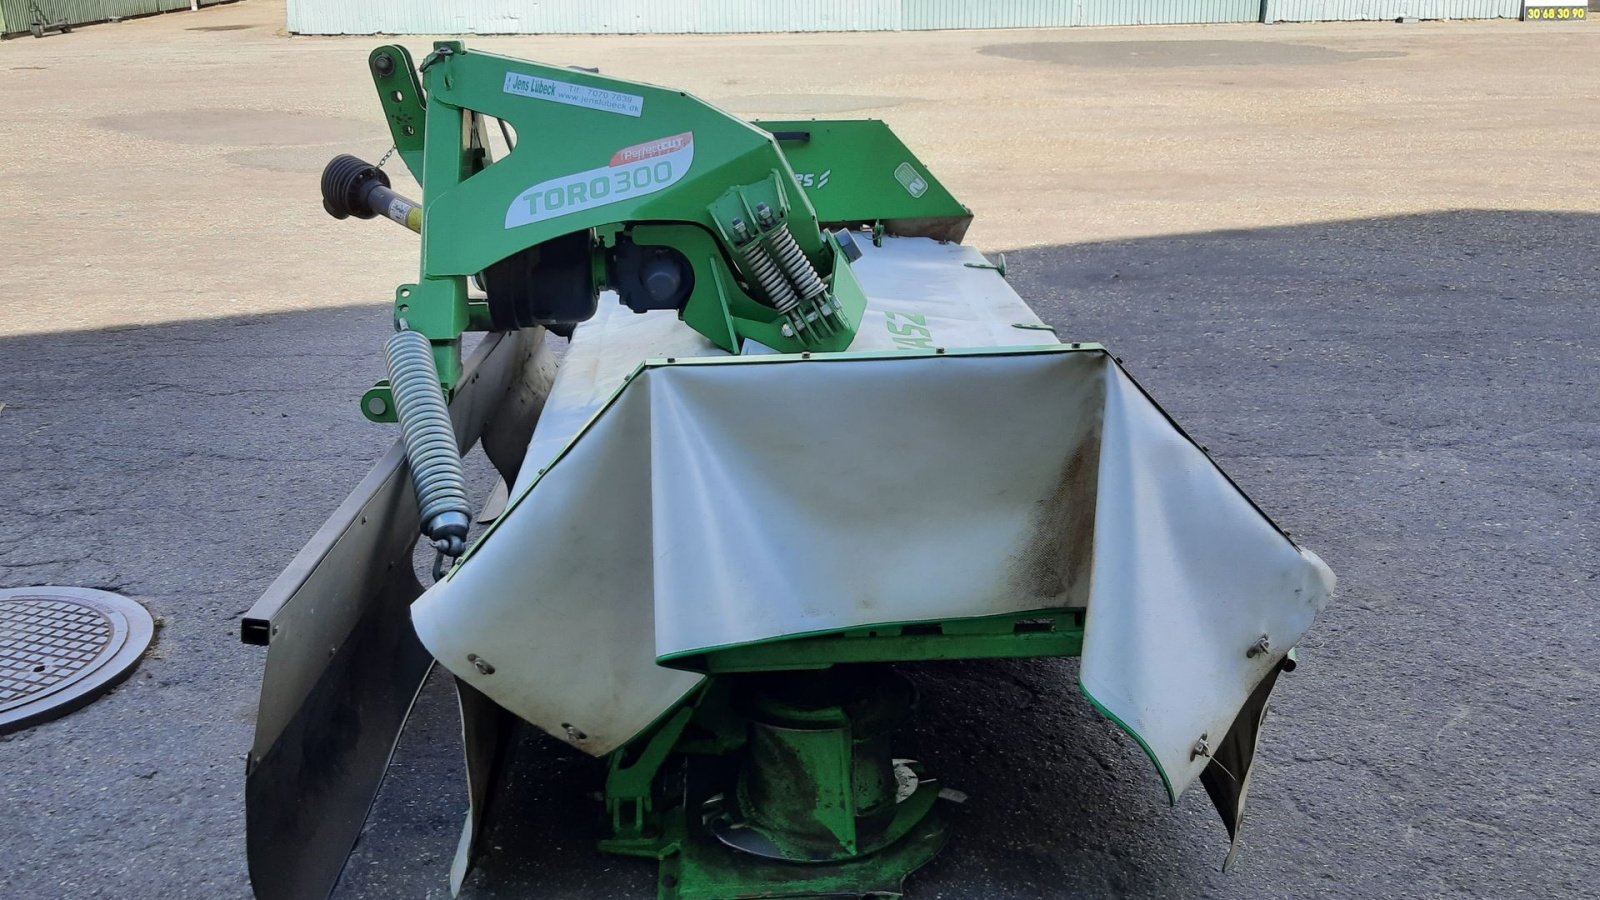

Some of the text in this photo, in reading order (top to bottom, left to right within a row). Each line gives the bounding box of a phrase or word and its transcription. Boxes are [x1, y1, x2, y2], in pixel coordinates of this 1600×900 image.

[1527, 8, 1584, 18] 30 68 30 90
[512, 75, 557, 97] Jens Lübeck
[587, 88, 609, 99] 7070
